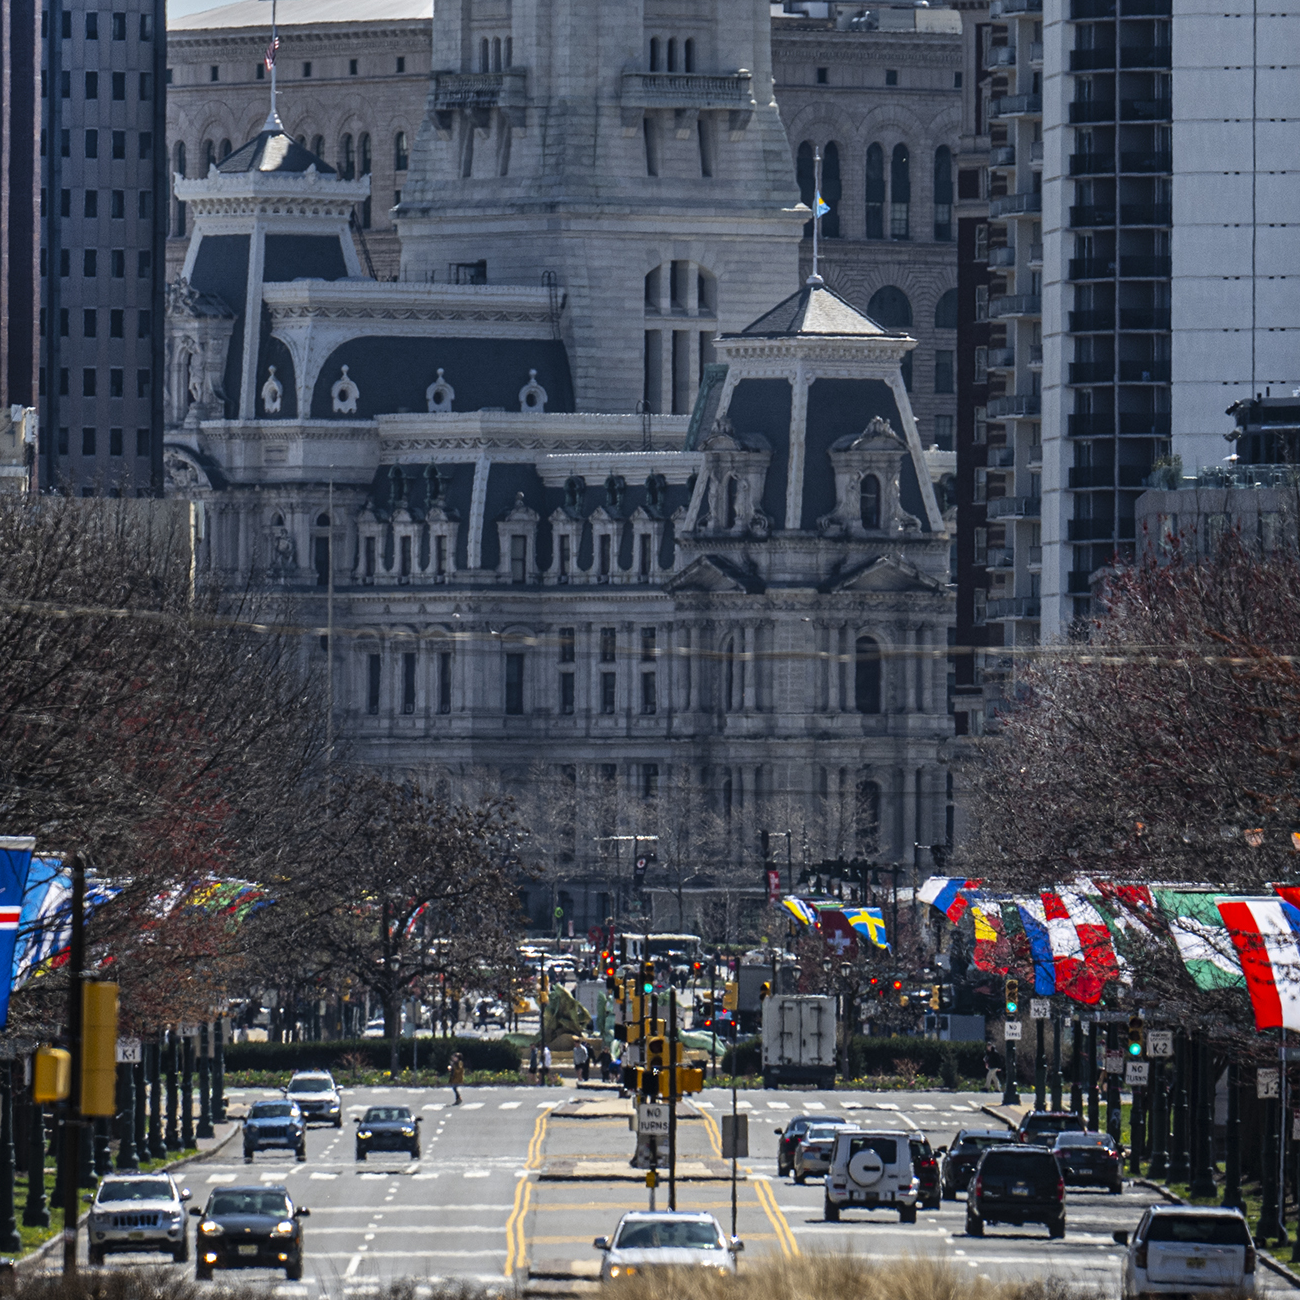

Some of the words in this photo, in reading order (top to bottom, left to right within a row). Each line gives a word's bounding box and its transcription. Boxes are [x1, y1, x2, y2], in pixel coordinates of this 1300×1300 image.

[1152, 1042, 1168, 1055] K-2
[1131, 1065, 1143, 1073] NO
[646, 1107, 662, 1118] NO
[640, 1121, 669, 1131] TURNS
